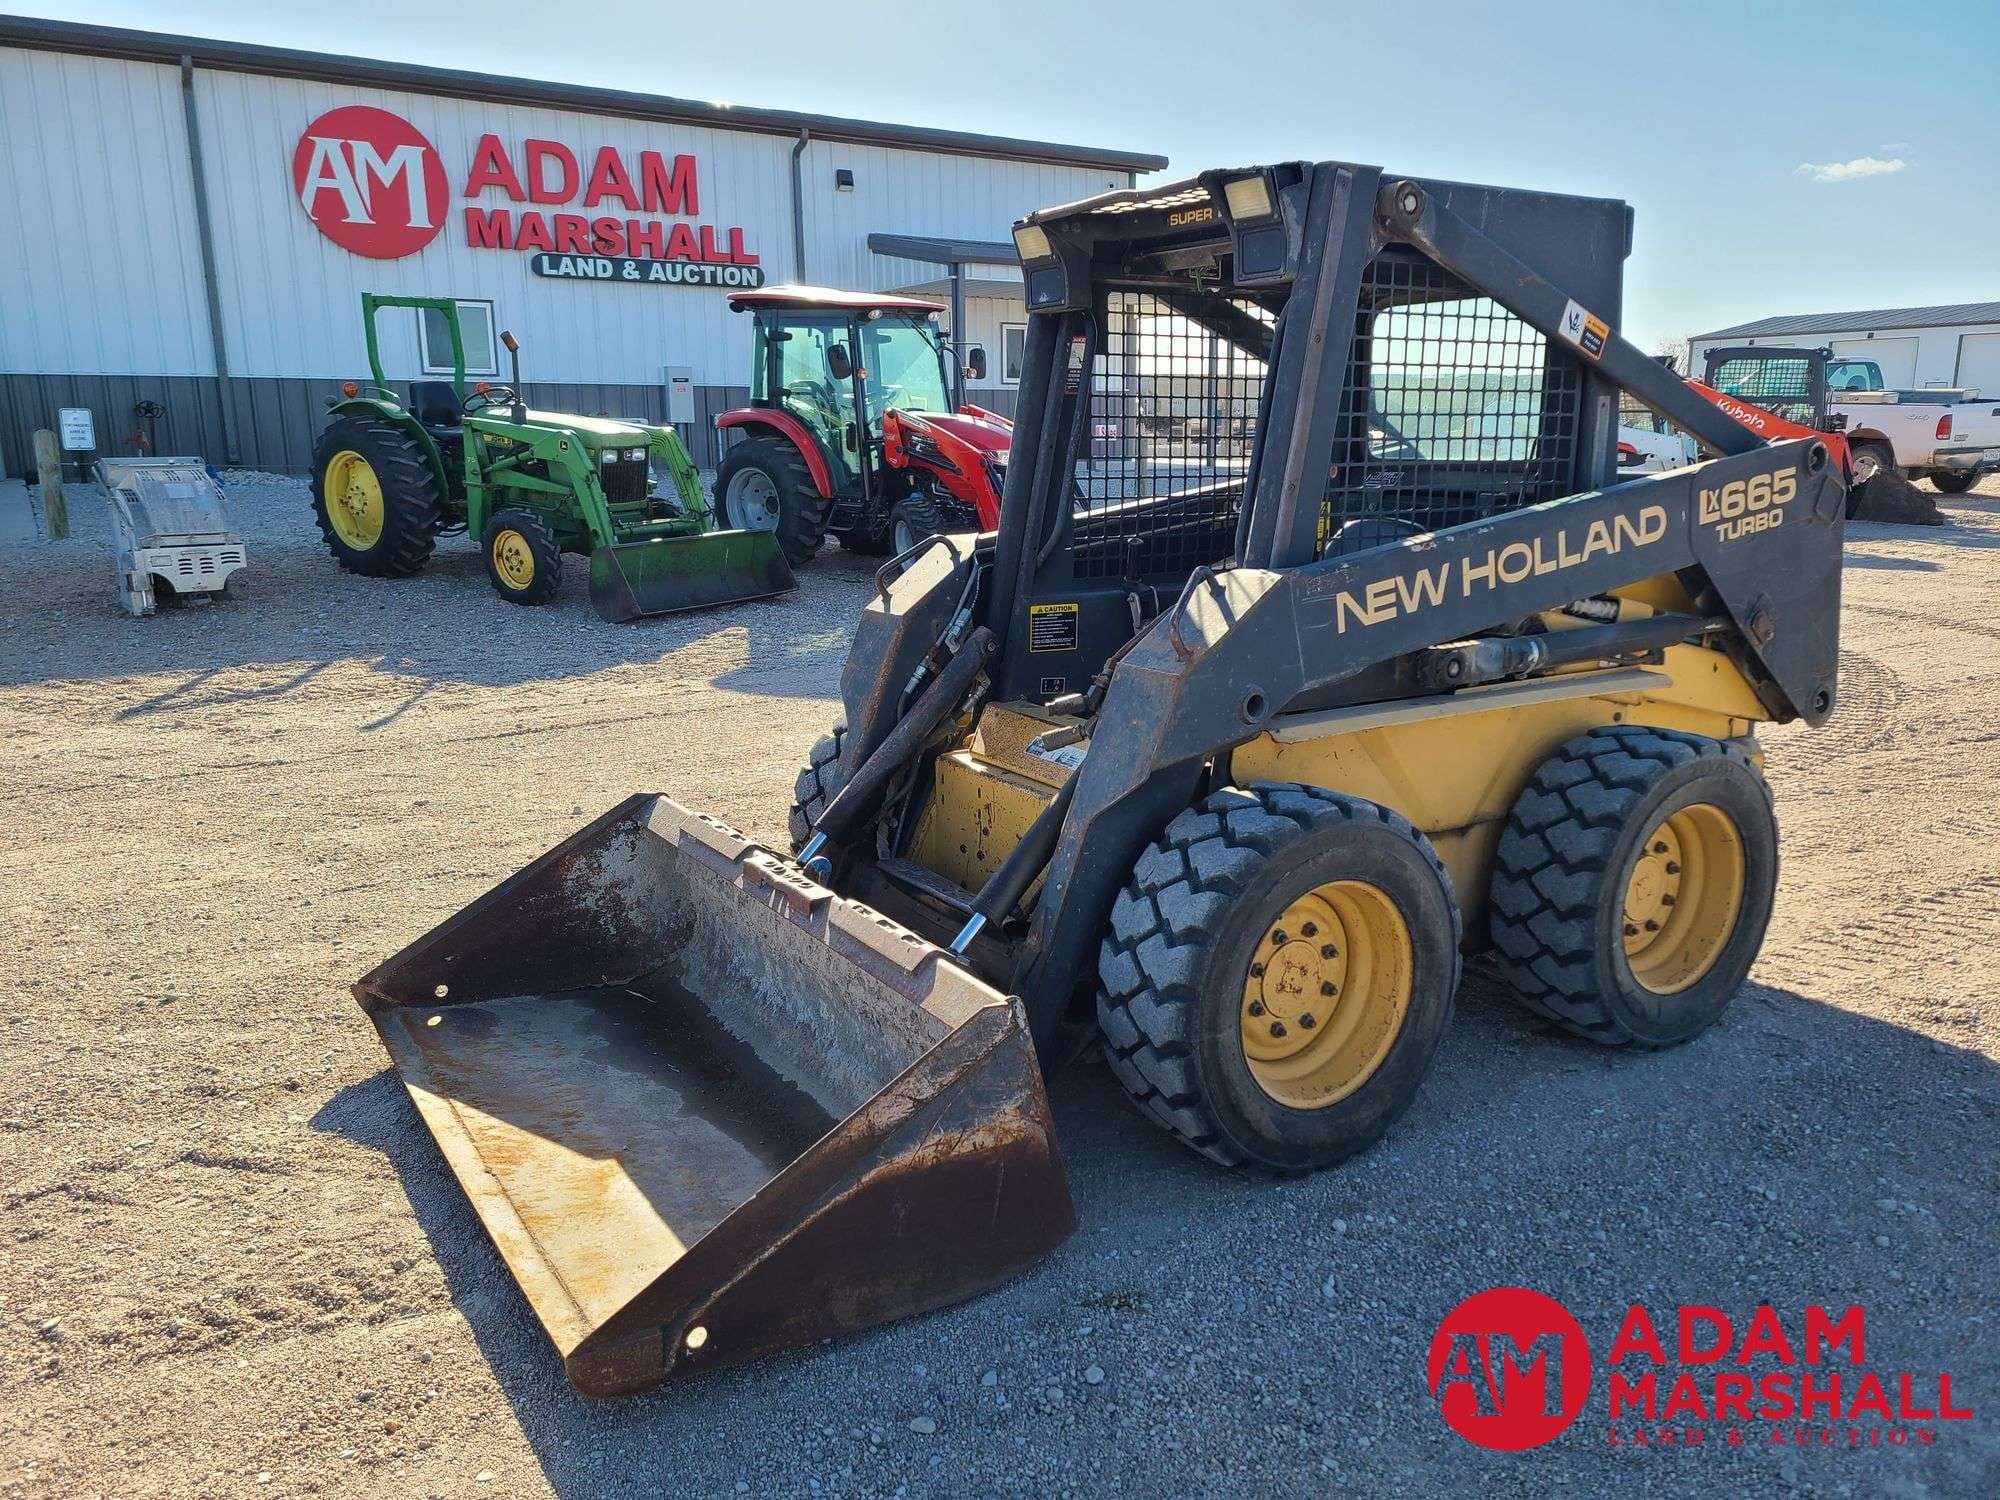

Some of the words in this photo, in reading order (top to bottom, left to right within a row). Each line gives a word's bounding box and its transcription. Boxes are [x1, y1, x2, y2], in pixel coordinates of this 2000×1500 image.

[302, 136, 435, 229] AM
[464, 133, 699, 216] ADAM
[1170, 208, 1213, 226] SUPER
[464, 207, 760, 265] MARSHALL
[542, 255, 613, 279] LAND
[623, 260, 641, 280] &
[648, 262, 758, 287] AUCTION
[1716, 398, 1766, 429] Kubota
[1715, 508, 1784, 544] TURBO
[1335, 563, 1450, 634] NEW
[1460, 505, 1668, 597] HOLLAND
[1044, 605, 1073, 613] CAUTION
